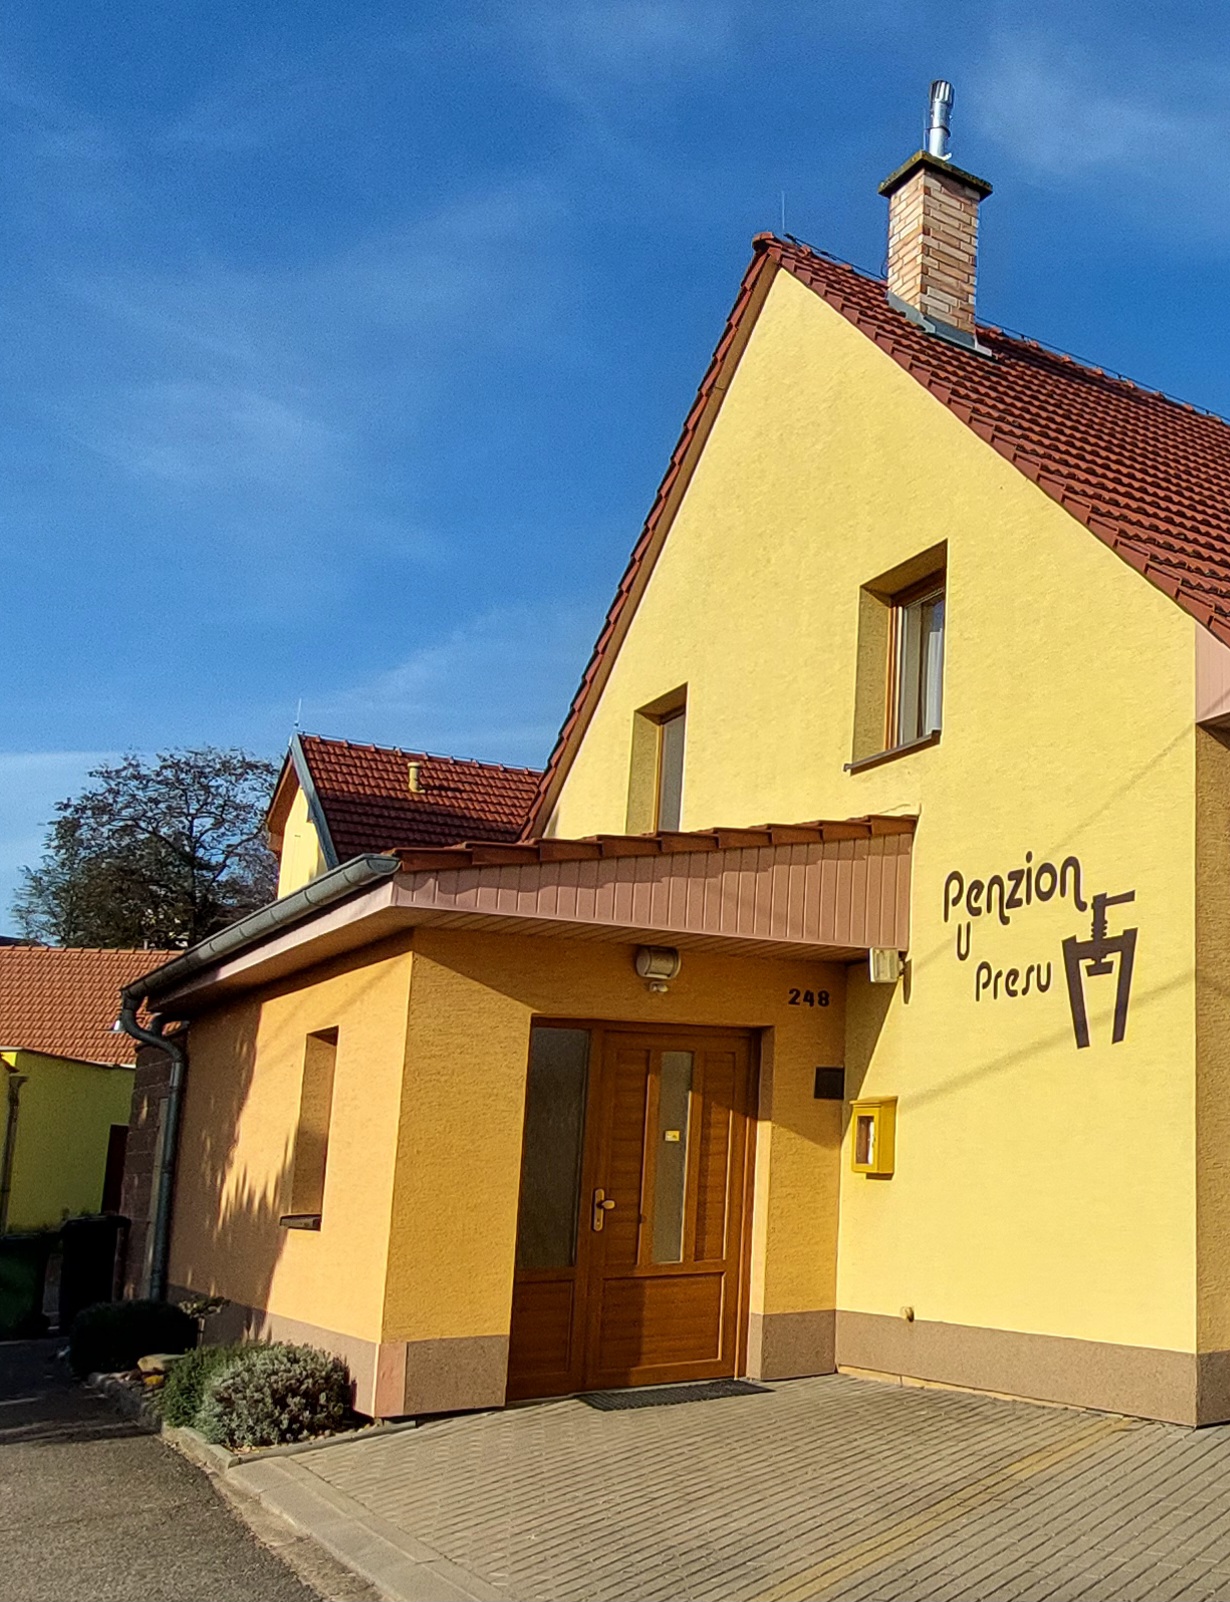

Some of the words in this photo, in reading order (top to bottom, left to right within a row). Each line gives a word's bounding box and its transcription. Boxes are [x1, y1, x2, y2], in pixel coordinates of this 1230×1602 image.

[943, 850, 1088, 926] Penzion
[956, 921, 971, 961] U
[788, 988, 831, 1007] 248
[975, 961, 1052, 1002] Presu
